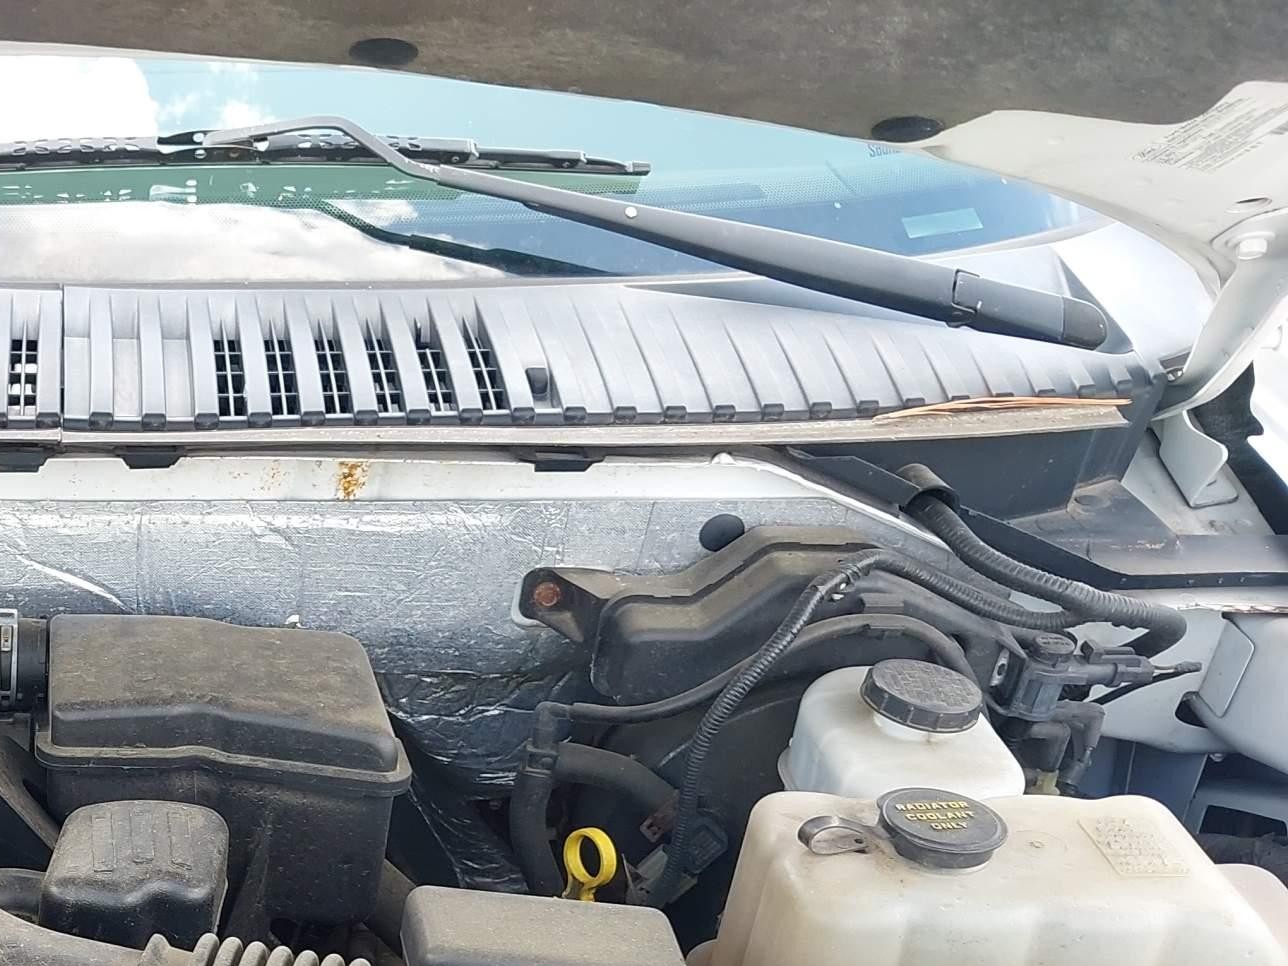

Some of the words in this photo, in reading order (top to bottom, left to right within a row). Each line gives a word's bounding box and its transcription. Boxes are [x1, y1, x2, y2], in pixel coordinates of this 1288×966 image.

[896, 801, 969, 811] RADIATOR
[905, 810, 975, 822] COOLANT
[930, 821, 969, 831] ONLY
